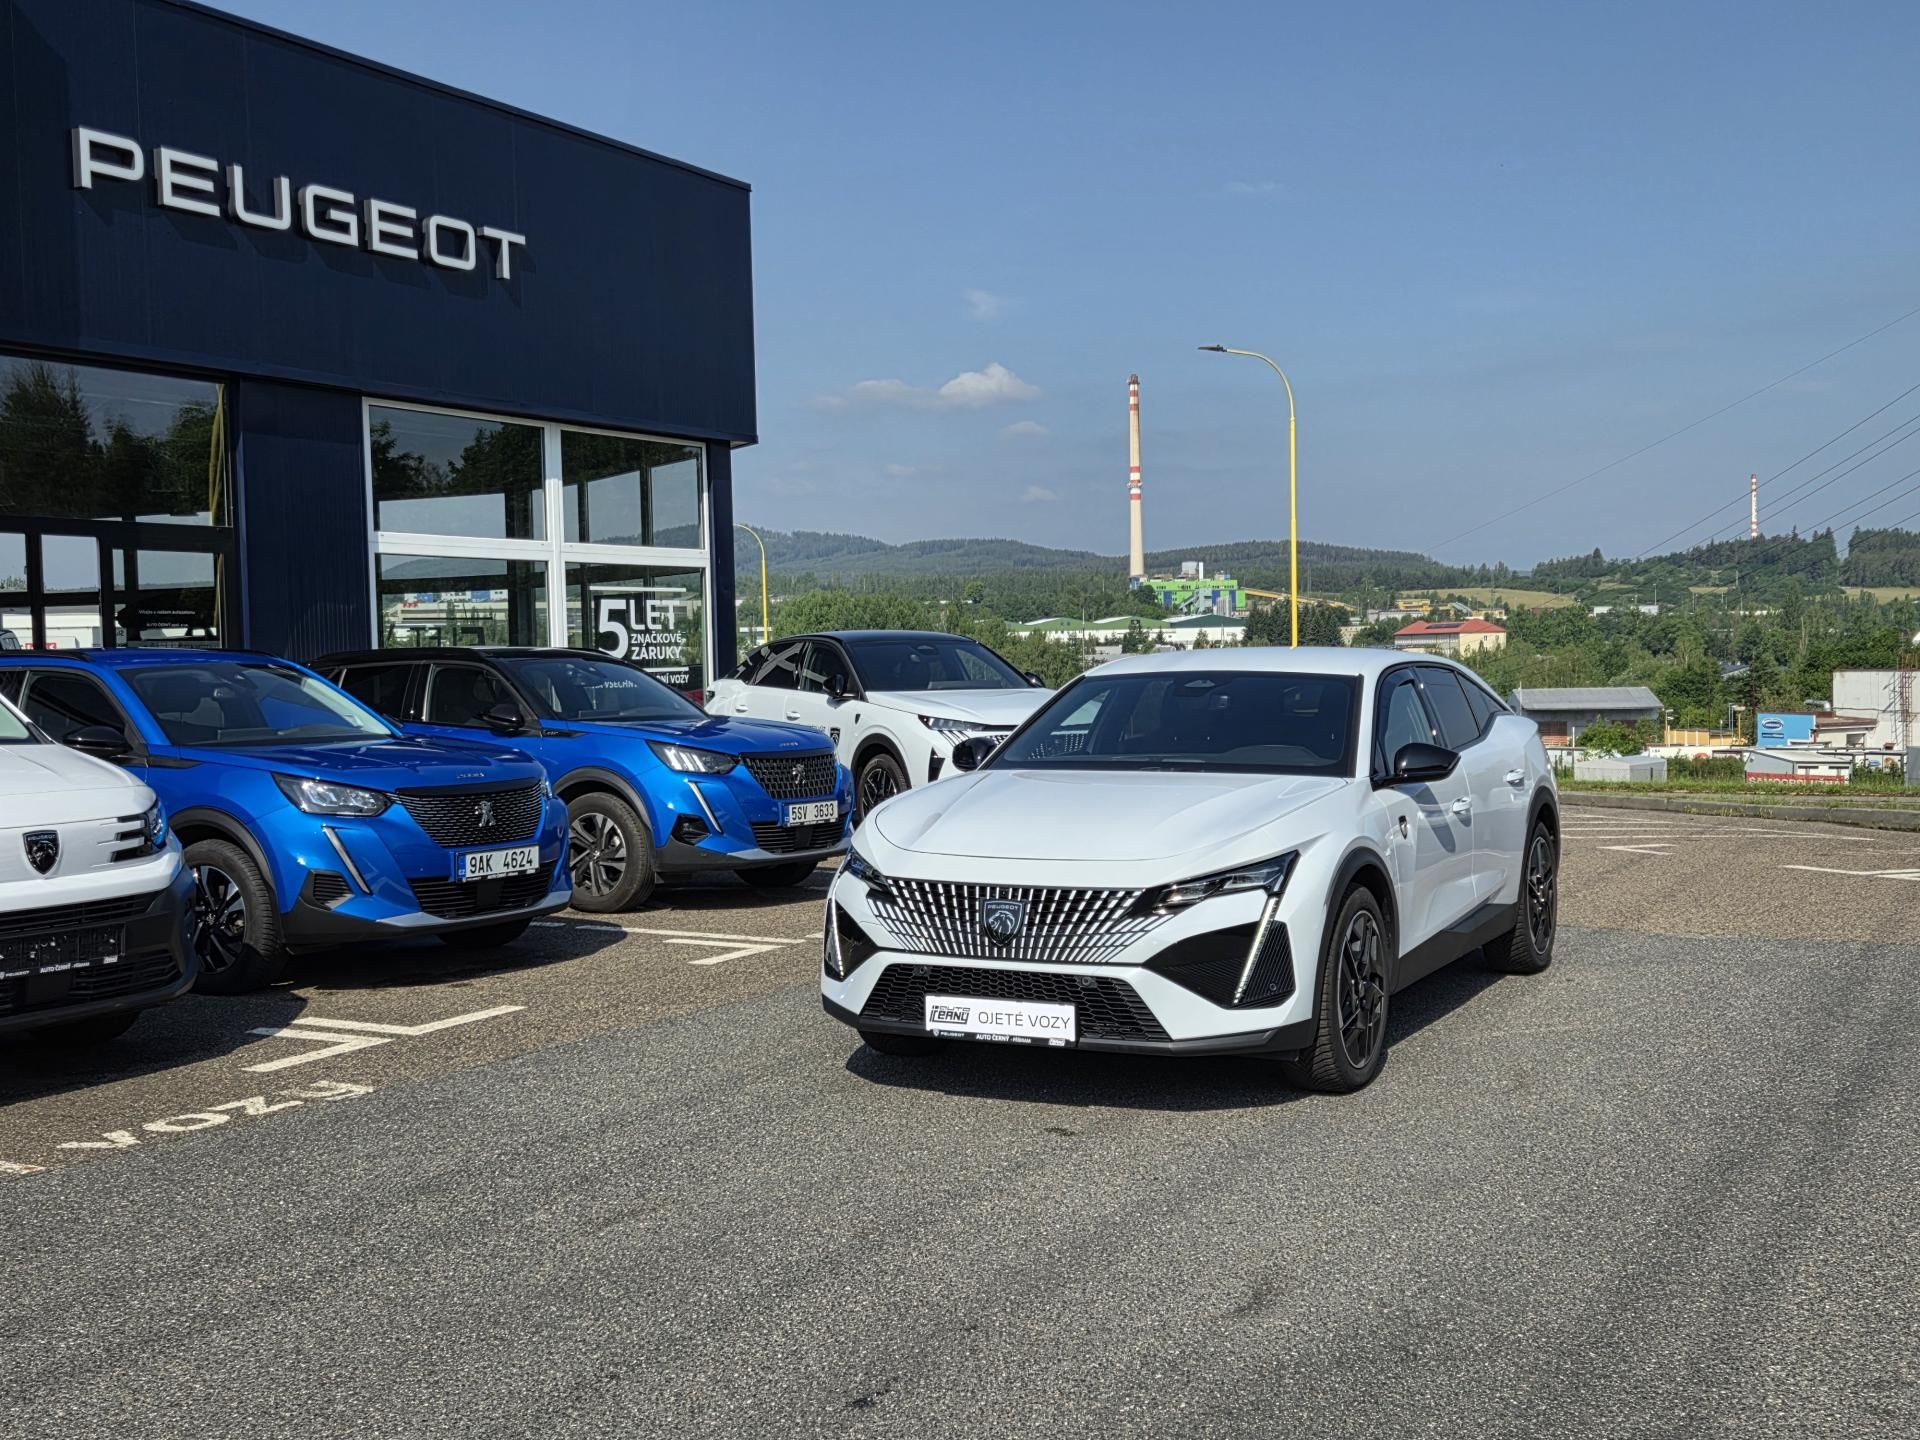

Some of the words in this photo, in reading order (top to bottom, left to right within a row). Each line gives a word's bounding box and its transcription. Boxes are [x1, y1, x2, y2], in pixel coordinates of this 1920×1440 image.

[72, 126, 526, 280] PEUGEOT
[598, 598, 629, 660] 5
[629, 599, 680, 630] LET
[630, 631, 682, 644] ZNAČKOVÉ
[631, 644, 682, 660] ZÁRUKY
[670, 673, 689, 684] VOZY
[791, 805, 808, 820] 5SV
[814, 803, 834, 818] 3633
[469, 854, 493, 874] 9AK
[503, 849, 533, 870] 4624
[978, 1011, 1024, 1027] OJETÉ
[1027, 1014, 1071, 1030] VOZY
